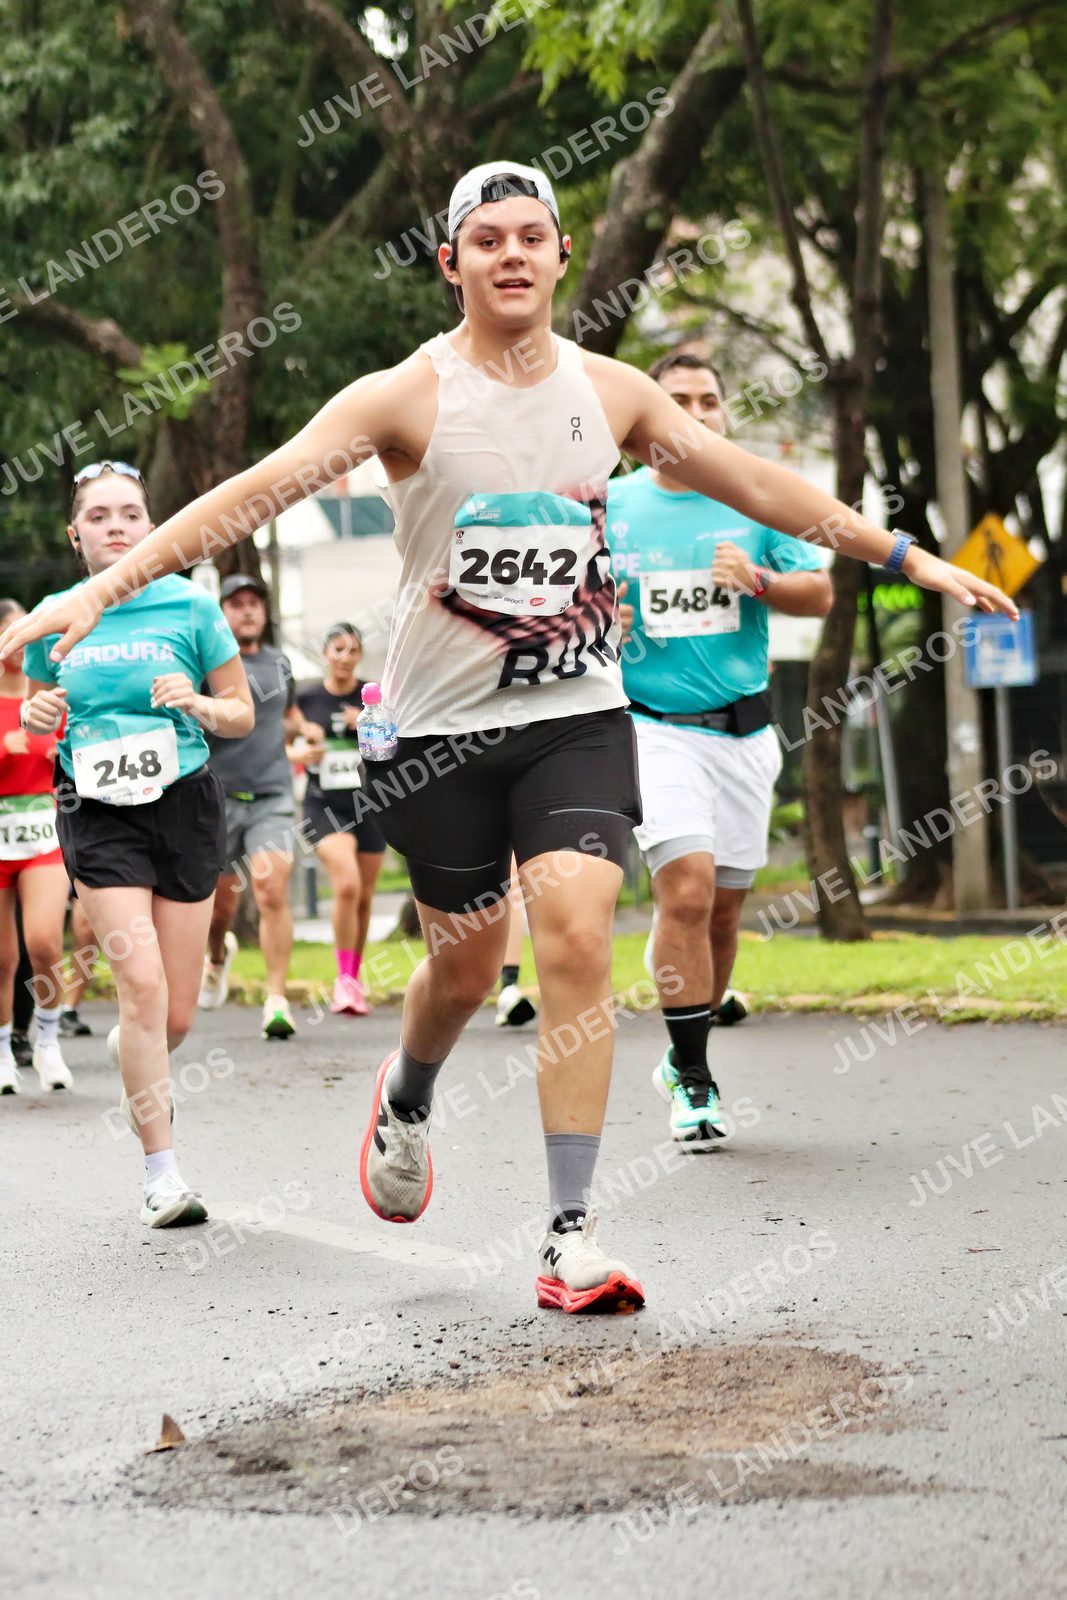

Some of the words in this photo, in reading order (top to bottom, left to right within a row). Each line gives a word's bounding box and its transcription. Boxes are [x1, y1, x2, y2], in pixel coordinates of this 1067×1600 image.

[459, 548, 578, 585] 2642
[650, 587, 731, 614] 5484
[93, 749, 162, 788] 248
